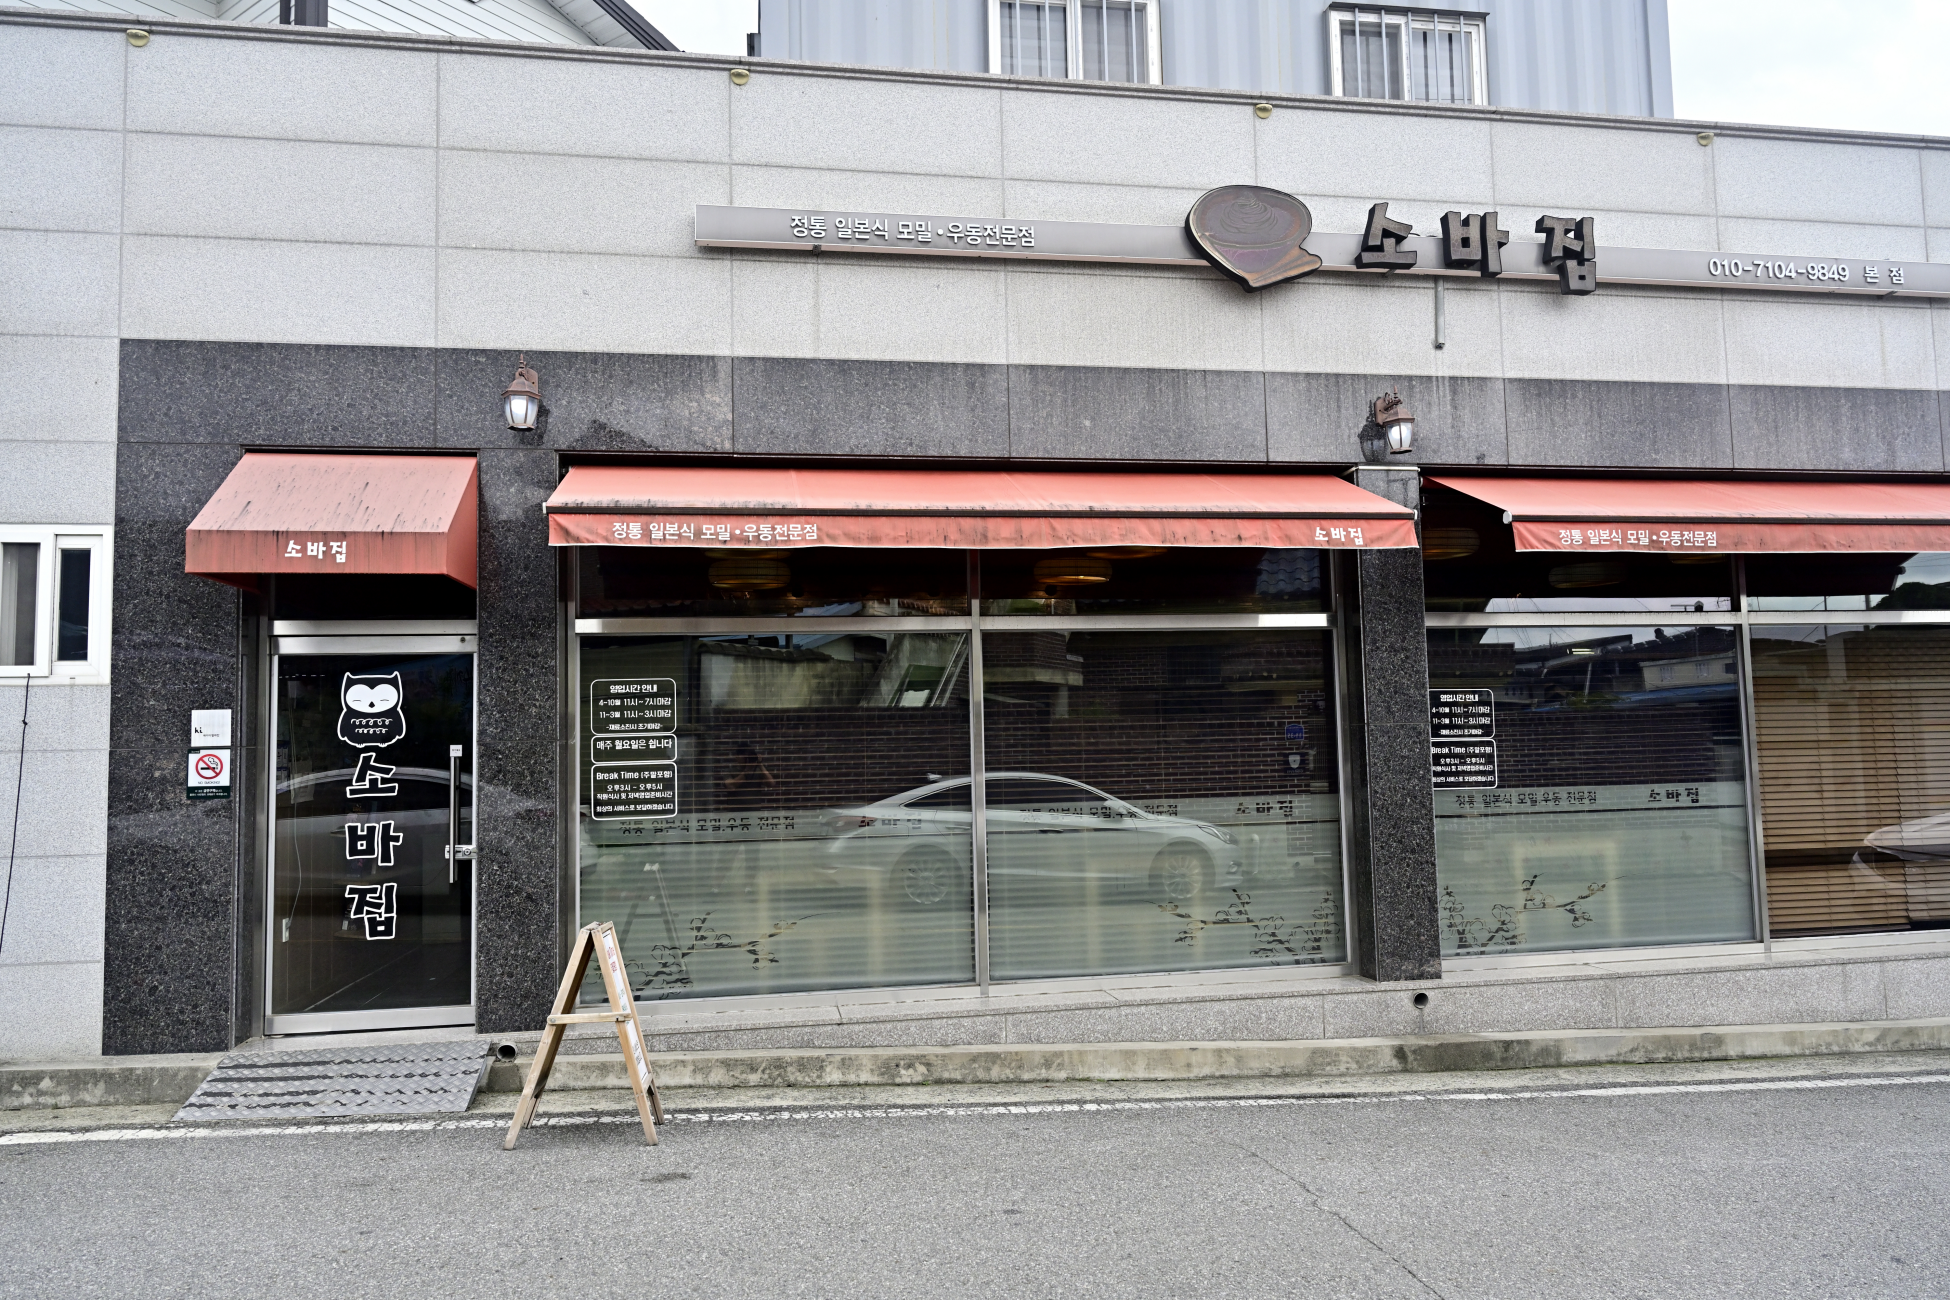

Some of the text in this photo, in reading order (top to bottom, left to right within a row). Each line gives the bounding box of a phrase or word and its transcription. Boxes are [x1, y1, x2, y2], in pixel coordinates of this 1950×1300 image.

[790, 215, 827, 239] 정통
[835, 217, 888, 240] 일본식
[1709, 257, 1849, 281] 010-7104-9849
[612, 522, 643, 539] 정통
[649, 522, 694, 539] 일본식
[1314, 526, 1364, 546] 소바집
[1558, 529, 1584, 545] 정통
[1587, 529, 1622, 545] 일본식
[609, 684, 658, 694] 영업시간 안내
[1440, 694, 1479, 702] 영업시간 안내
[596, 738, 673, 750] 매주 월요일은 쉽니다
[1431, 746, 1450, 754] Break
[1450, 746, 1466, 754] Time
[596, 771, 619, 780] Break
[620, 770, 640, 780] Time
[606, 783, 631, 792] 오후3시
[639, 782, 663, 791] 오후5시
